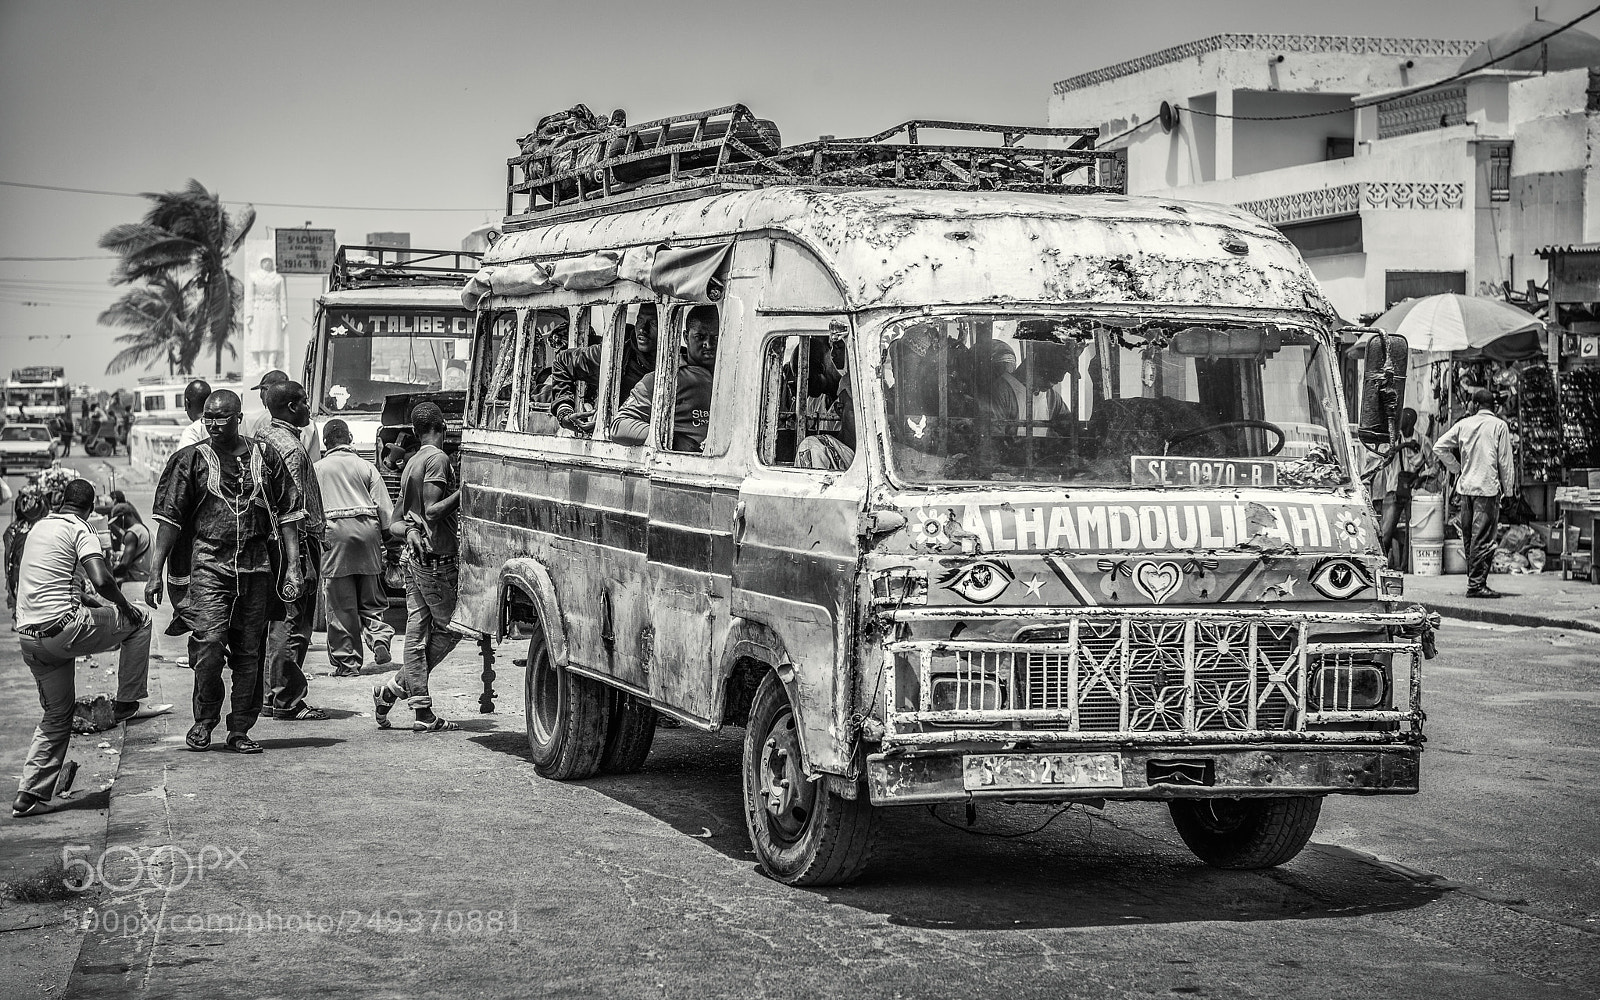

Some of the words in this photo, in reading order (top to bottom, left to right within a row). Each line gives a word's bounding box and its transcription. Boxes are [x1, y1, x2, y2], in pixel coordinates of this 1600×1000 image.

[296, 235, 324, 245] LOUIS
[368, 316, 446, 334] TALIBE
[1148, 460, 1173, 486] SL
[1189, 461, 1236, 486] 0970
